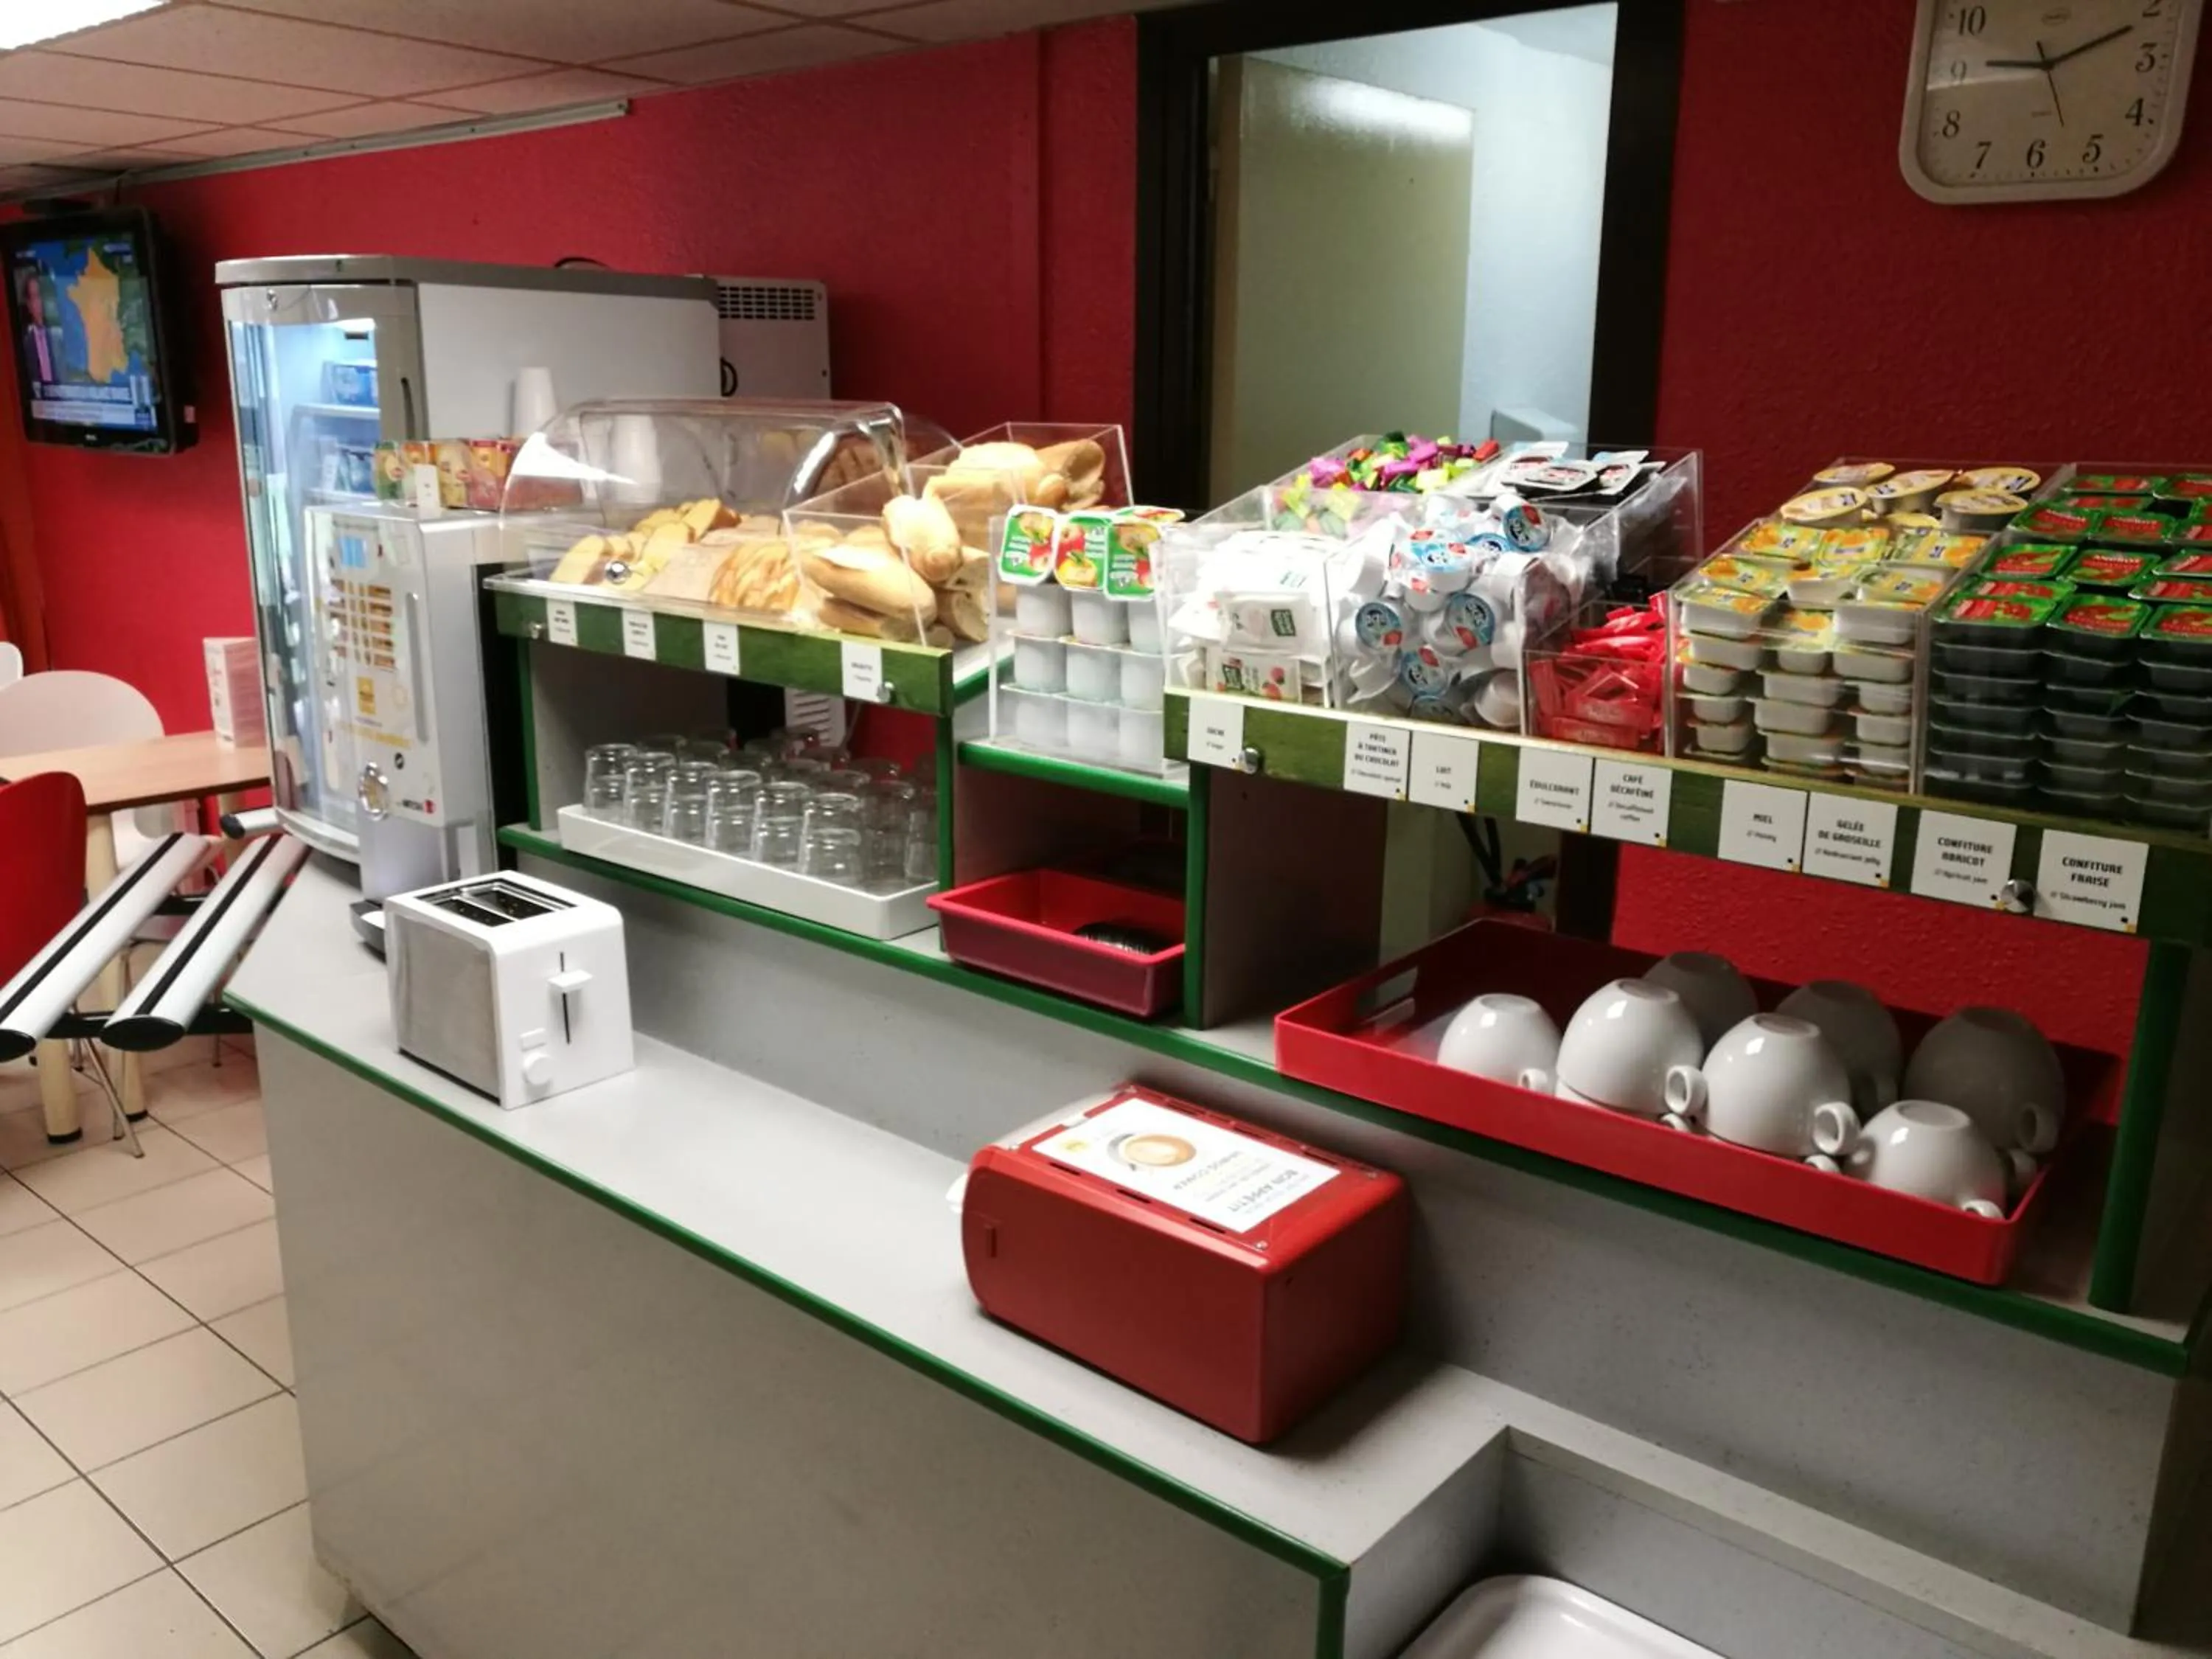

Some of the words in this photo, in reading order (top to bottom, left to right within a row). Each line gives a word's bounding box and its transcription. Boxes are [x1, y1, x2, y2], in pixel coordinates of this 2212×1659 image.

[1957, 6, 1986, 36] 10
[2135, 43, 2157, 72] 3
[1950, 60, 1967, 83] 9
[2125, 98, 2144, 126] 4
[1941, 111, 1961, 138] 8
[1975, 141, 1992, 170] 7
[2026, 139, 2047, 169] 6
[2081, 135, 2104, 165] 5
[1365, 754, 1400, 768] CHOCOLAT
[1436, 766, 1452, 774] LAIT
[1529, 779, 1580, 796] ÉDULCORANT
[1622, 773, 1644, 785] CAFÉ
[1753, 813, 1773, 825] MIEL
[1837, 818, 1865, 833] GELÉE
[1818, 830, 1830, 840] DE
[1832, 832, 1882, 849] GROSEILLE
[1937, 836, 1994, 855] CONFITURE
[1941, 852, 1986, 868] ABRICOT
[2062, 856, 2124, 875] CONFITURE
[2070, 872, 2111, 888] FRAISE
[2059, 891, 2108, 909] Strawberry
[2109, 900, 2127, 911] jam
